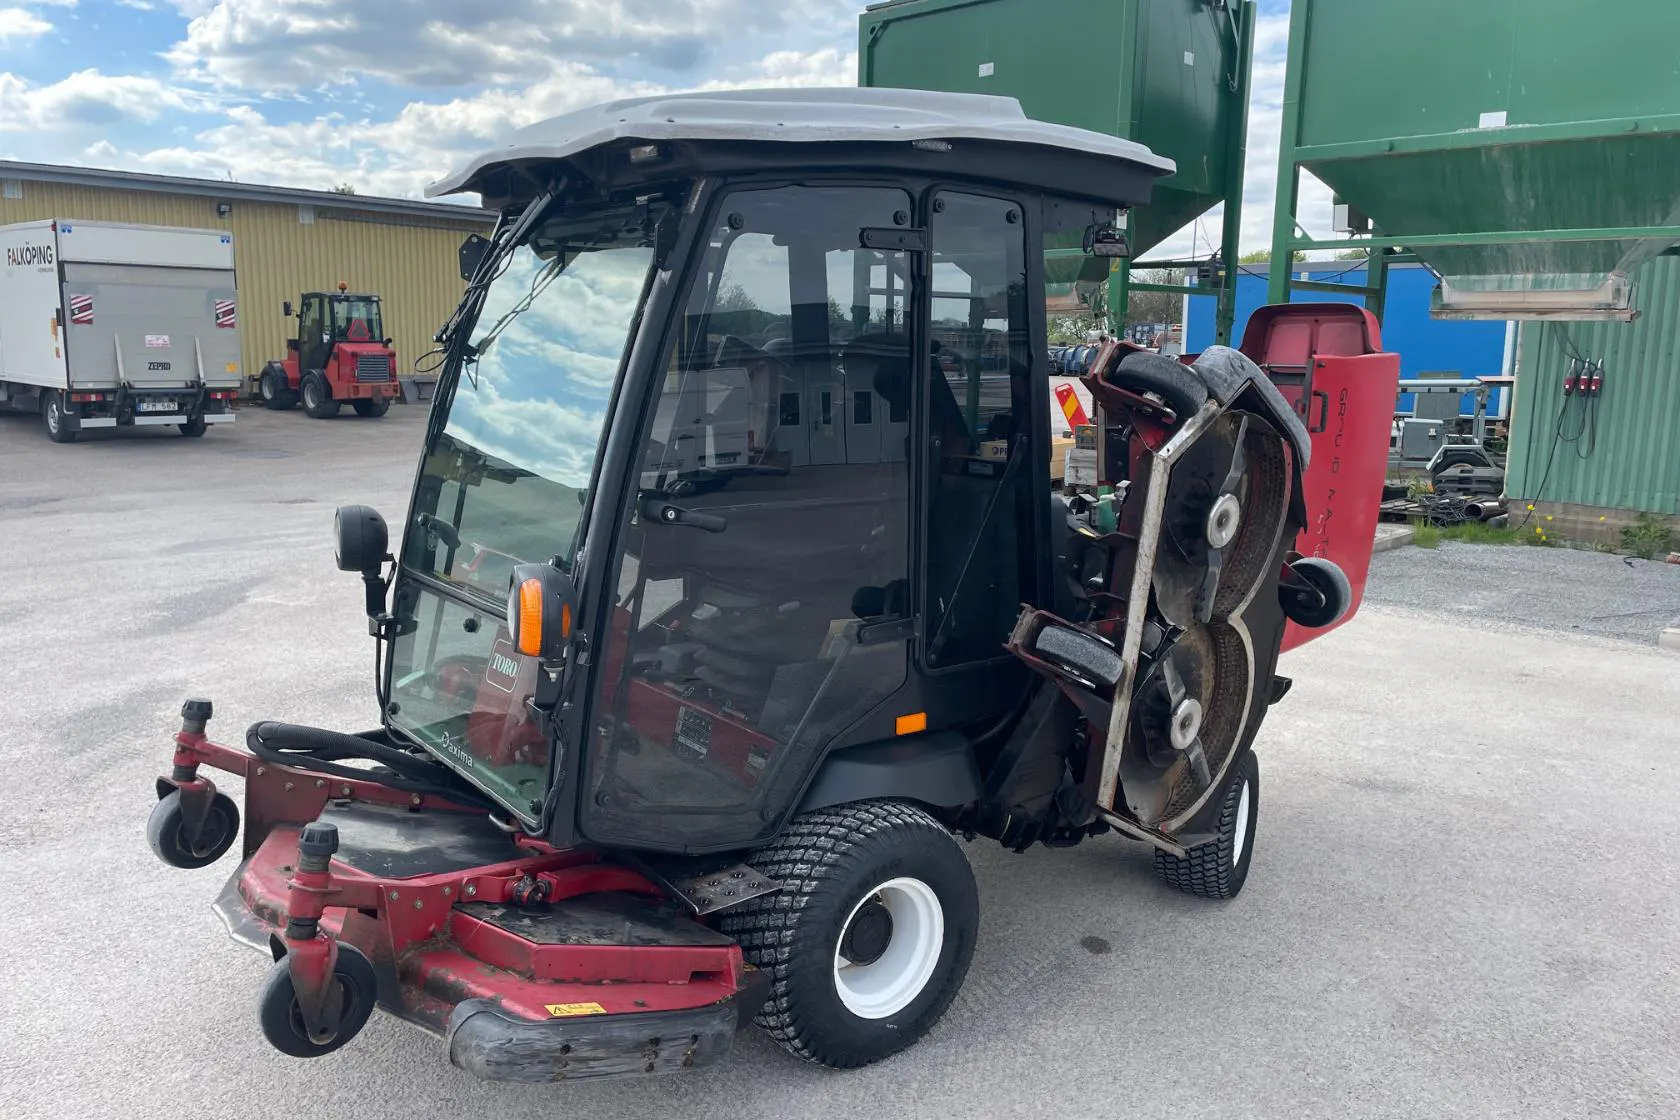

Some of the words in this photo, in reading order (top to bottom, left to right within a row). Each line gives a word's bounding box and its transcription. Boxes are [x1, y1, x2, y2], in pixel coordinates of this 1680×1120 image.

[7, 241, 53, 266] FALKÖPING
[148, 361, 171, 370] ZEPRO
[492, 653, 517, 677] TORO
